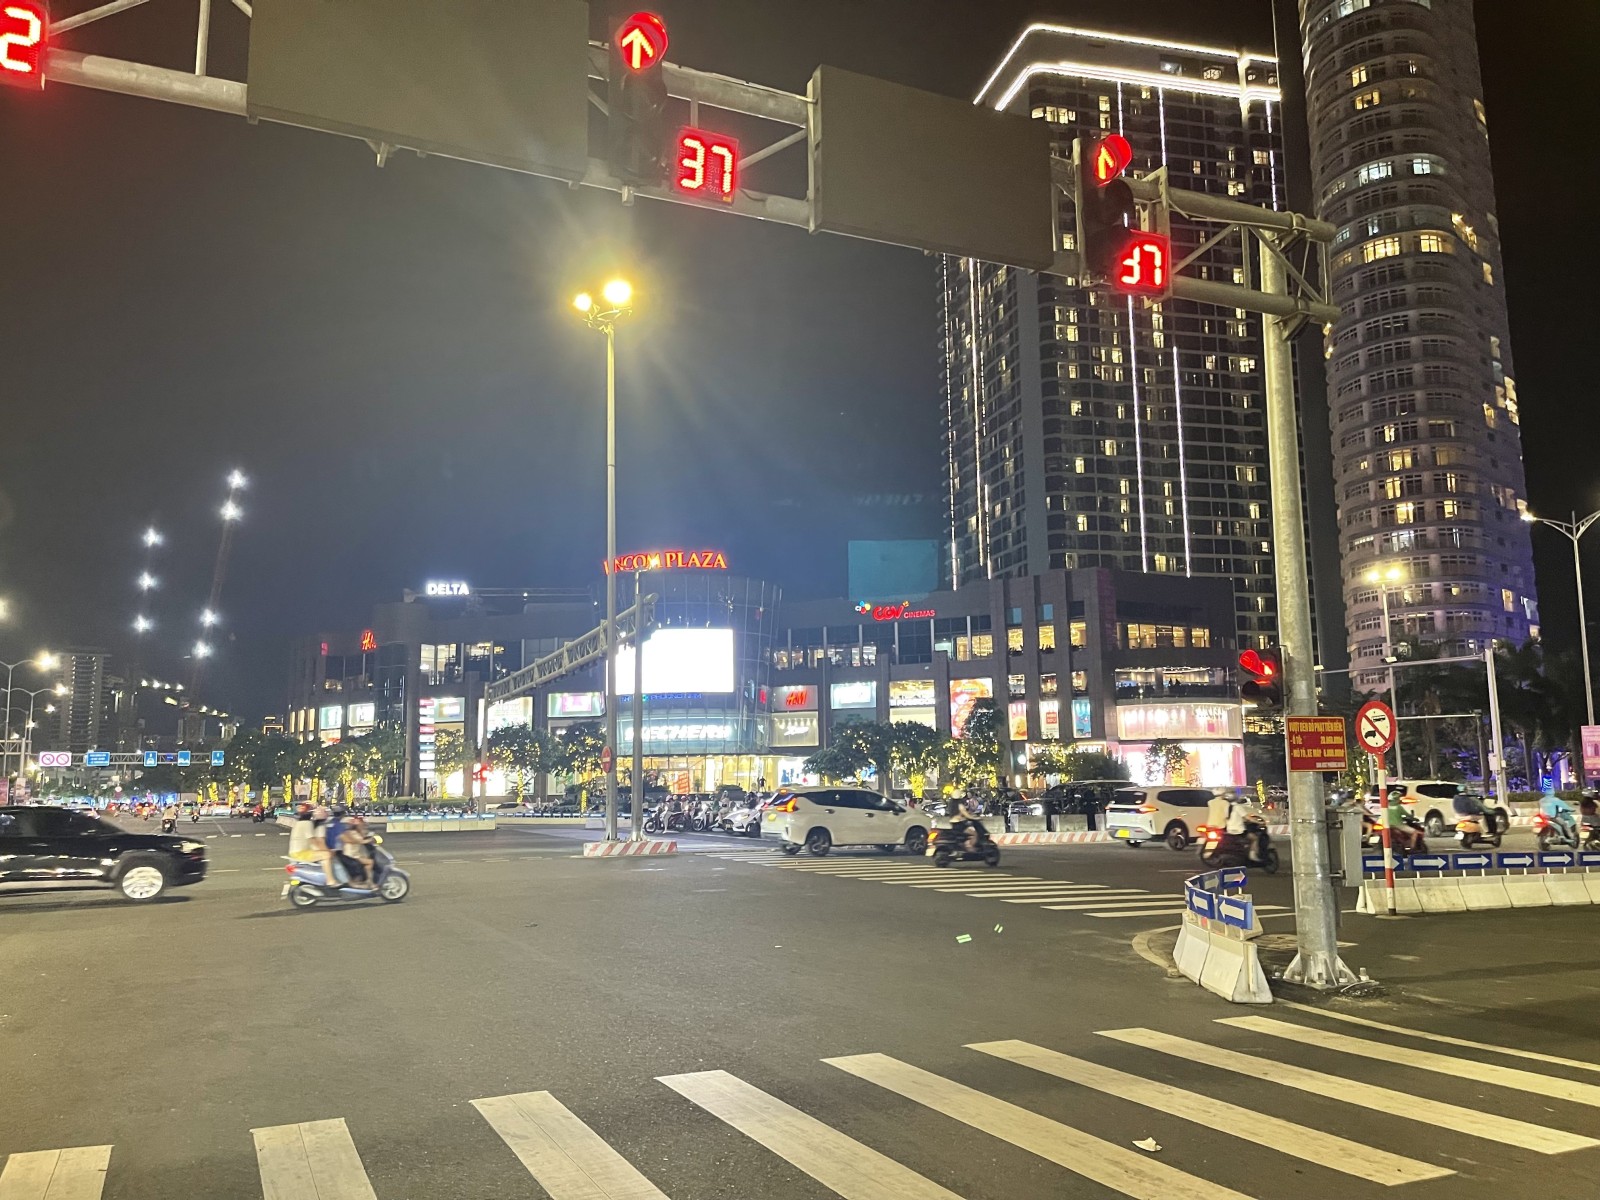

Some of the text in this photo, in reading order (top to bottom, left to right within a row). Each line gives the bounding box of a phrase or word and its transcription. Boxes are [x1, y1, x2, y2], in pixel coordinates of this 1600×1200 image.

[0, 6, 42, 73] 2
[680, 138, 733, 193] 37
[1121, 244, 1162, 286] 37
[665, 551, 727, 569] PLAZA
[427, 583, 470, 595] DELTA
[903, 609, 936, 619] CINEMAS
